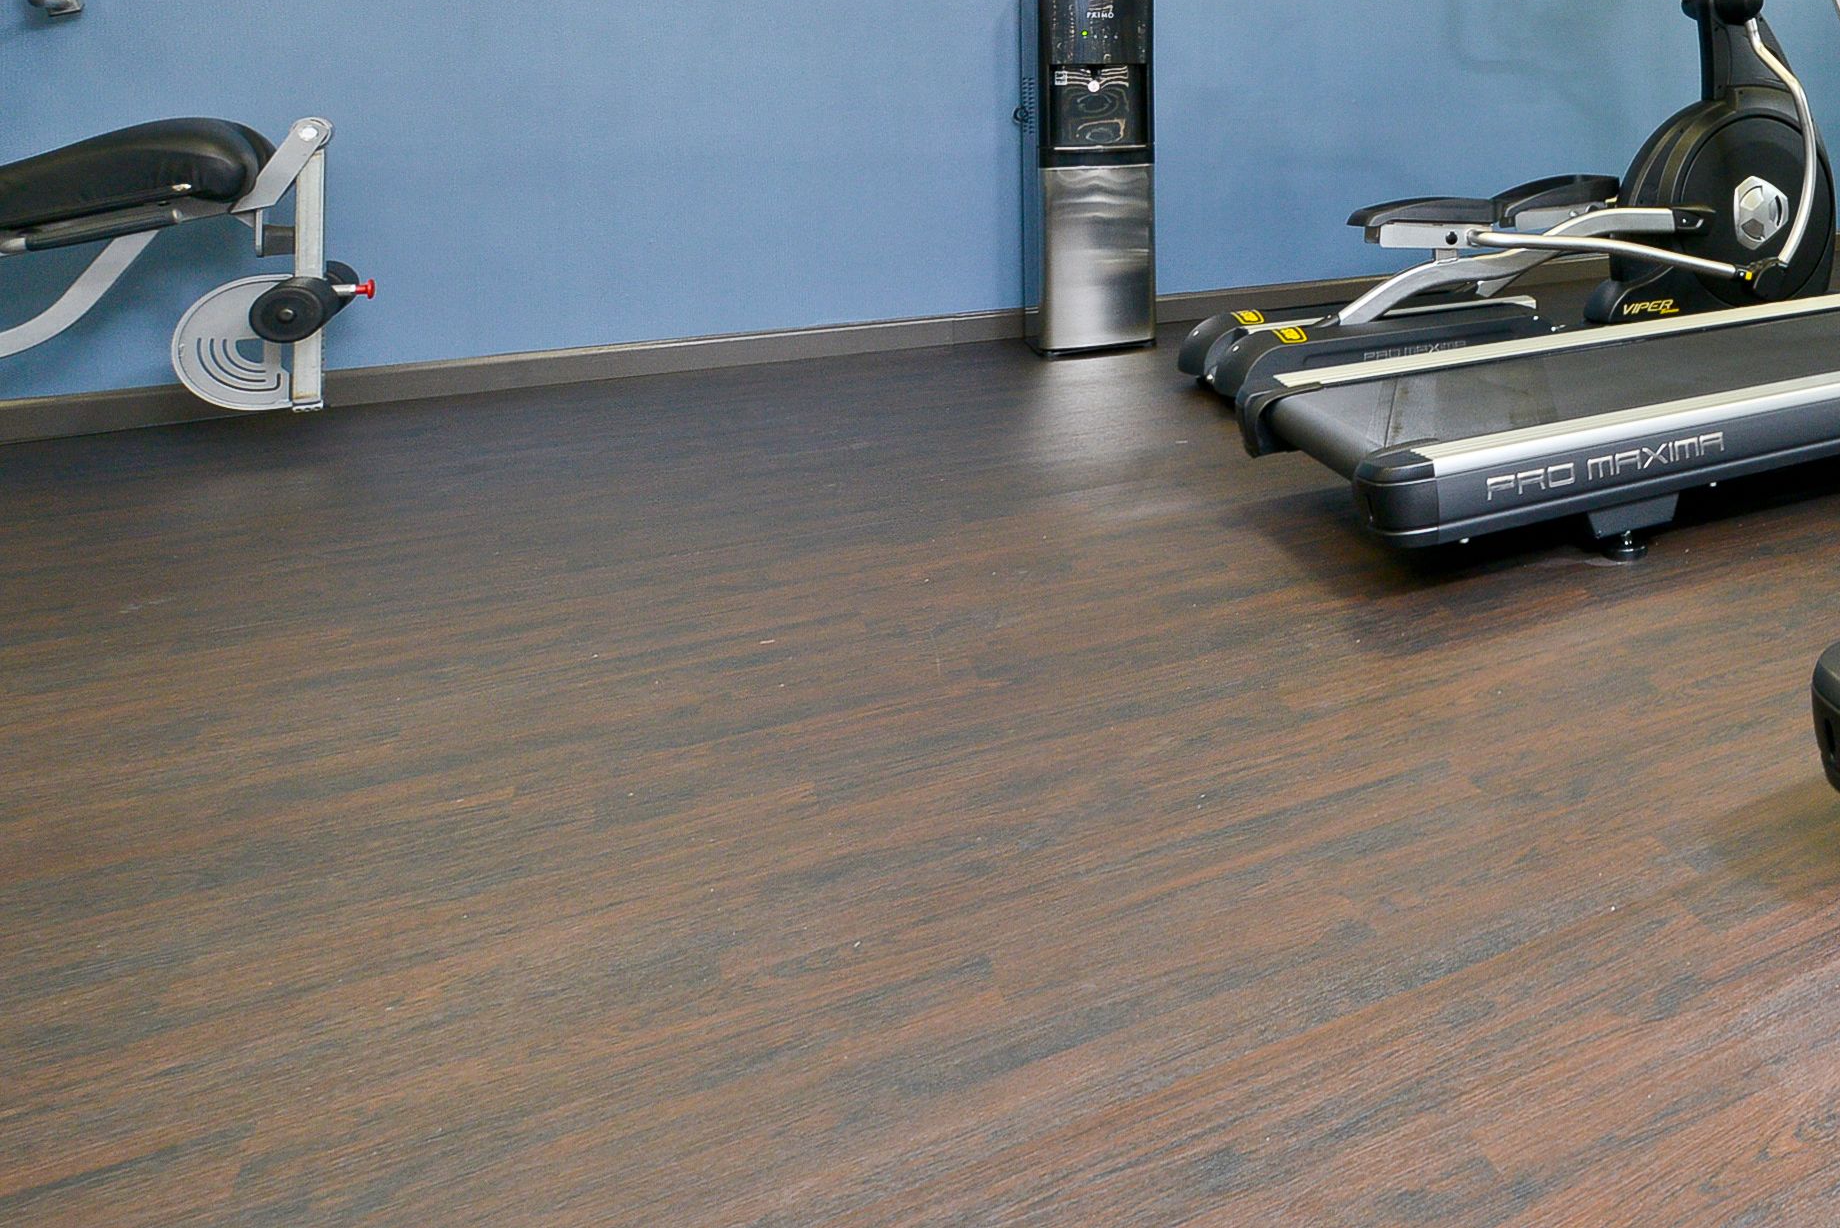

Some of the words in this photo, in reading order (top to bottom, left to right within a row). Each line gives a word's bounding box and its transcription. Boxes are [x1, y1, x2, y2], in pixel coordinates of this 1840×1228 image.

[1623, 299, 1674, 315] VIPER
[1486, 462, 1575, 501] PRO
[1586, 431, 1725, 481] MAXIMA
